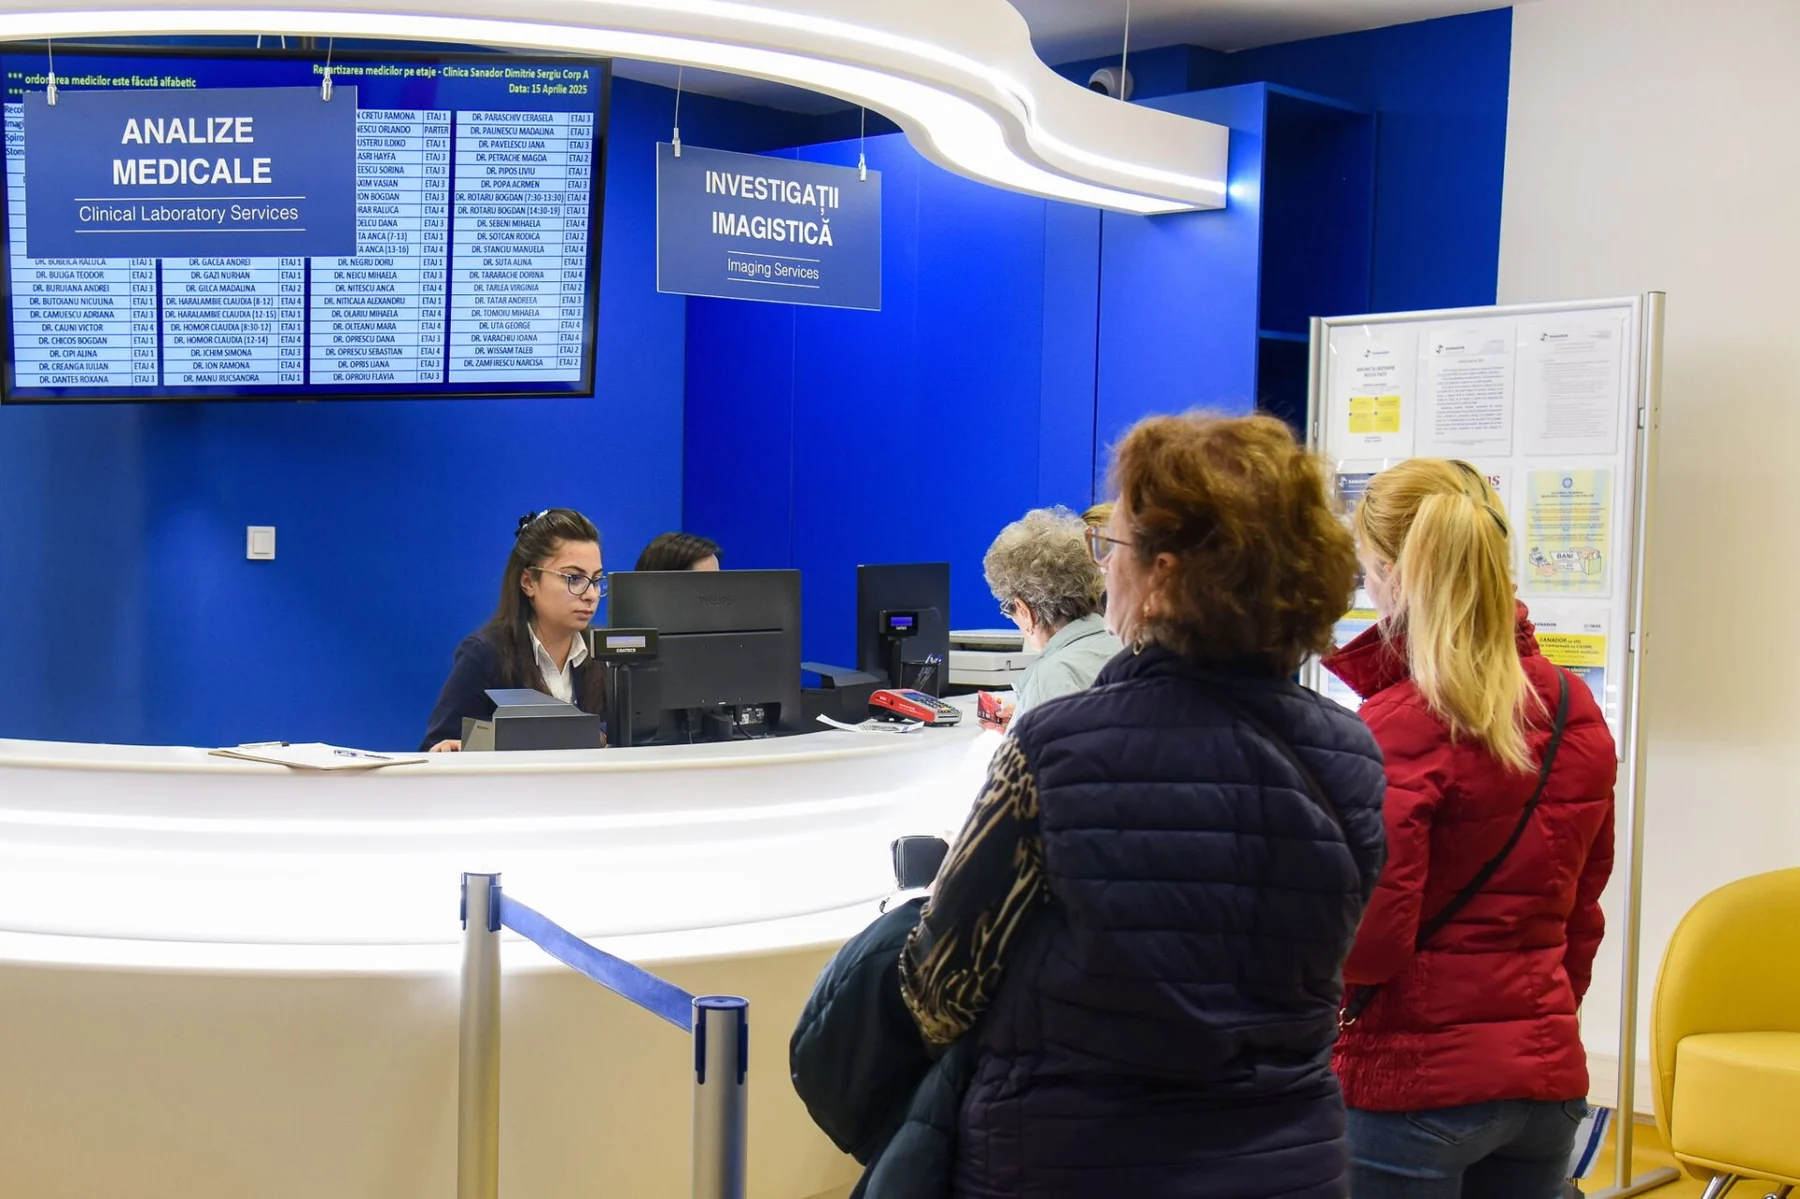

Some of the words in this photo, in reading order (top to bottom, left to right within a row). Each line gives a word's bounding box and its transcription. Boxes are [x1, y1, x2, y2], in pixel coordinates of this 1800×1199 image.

[72, 76, 110, 85] medicilor
[113, 78, 130, 86] este
[160, 76, 196, 87] alfabetic
[313, 65, 363, 74] Reartizarea
[366, 66, 402, 75] medicilor
[404, 69, 414, 77] pe
[416, 67, 436, 78] etaje
[443, 67, 468, 77] Clinica
[471, 68, 503, 78] Sanador
[505, 68, 535, 78] Dimitrie
[537, 69, 560, 80] Sergiu
[563, 70, 581, 81] Corp
[583, 70, 588, 79] A
[509, 84, 529, 93] Data:
[532, 84, 540, 93] 15
[542, 85, 567, 95] Aprilie
[569, 85, 587, 94] 2025
[122, 117, 254, 144] ANALIZE
[113, 158, 272, 184] MEDICALE
[706, 171, 838, 215] INVESTIGAȚII
[80, 206, 135, 222] Clinical
[142, 205, 225, 224] Laboratory
[231, 205, 298, 220] Services
[713, 212, 833, 246] IMAGISTICĂ
[728, 259, 770, 277] Imaging
[774, 263, 819, 279] Services
[244, 336, 268, 345] (12-14)
